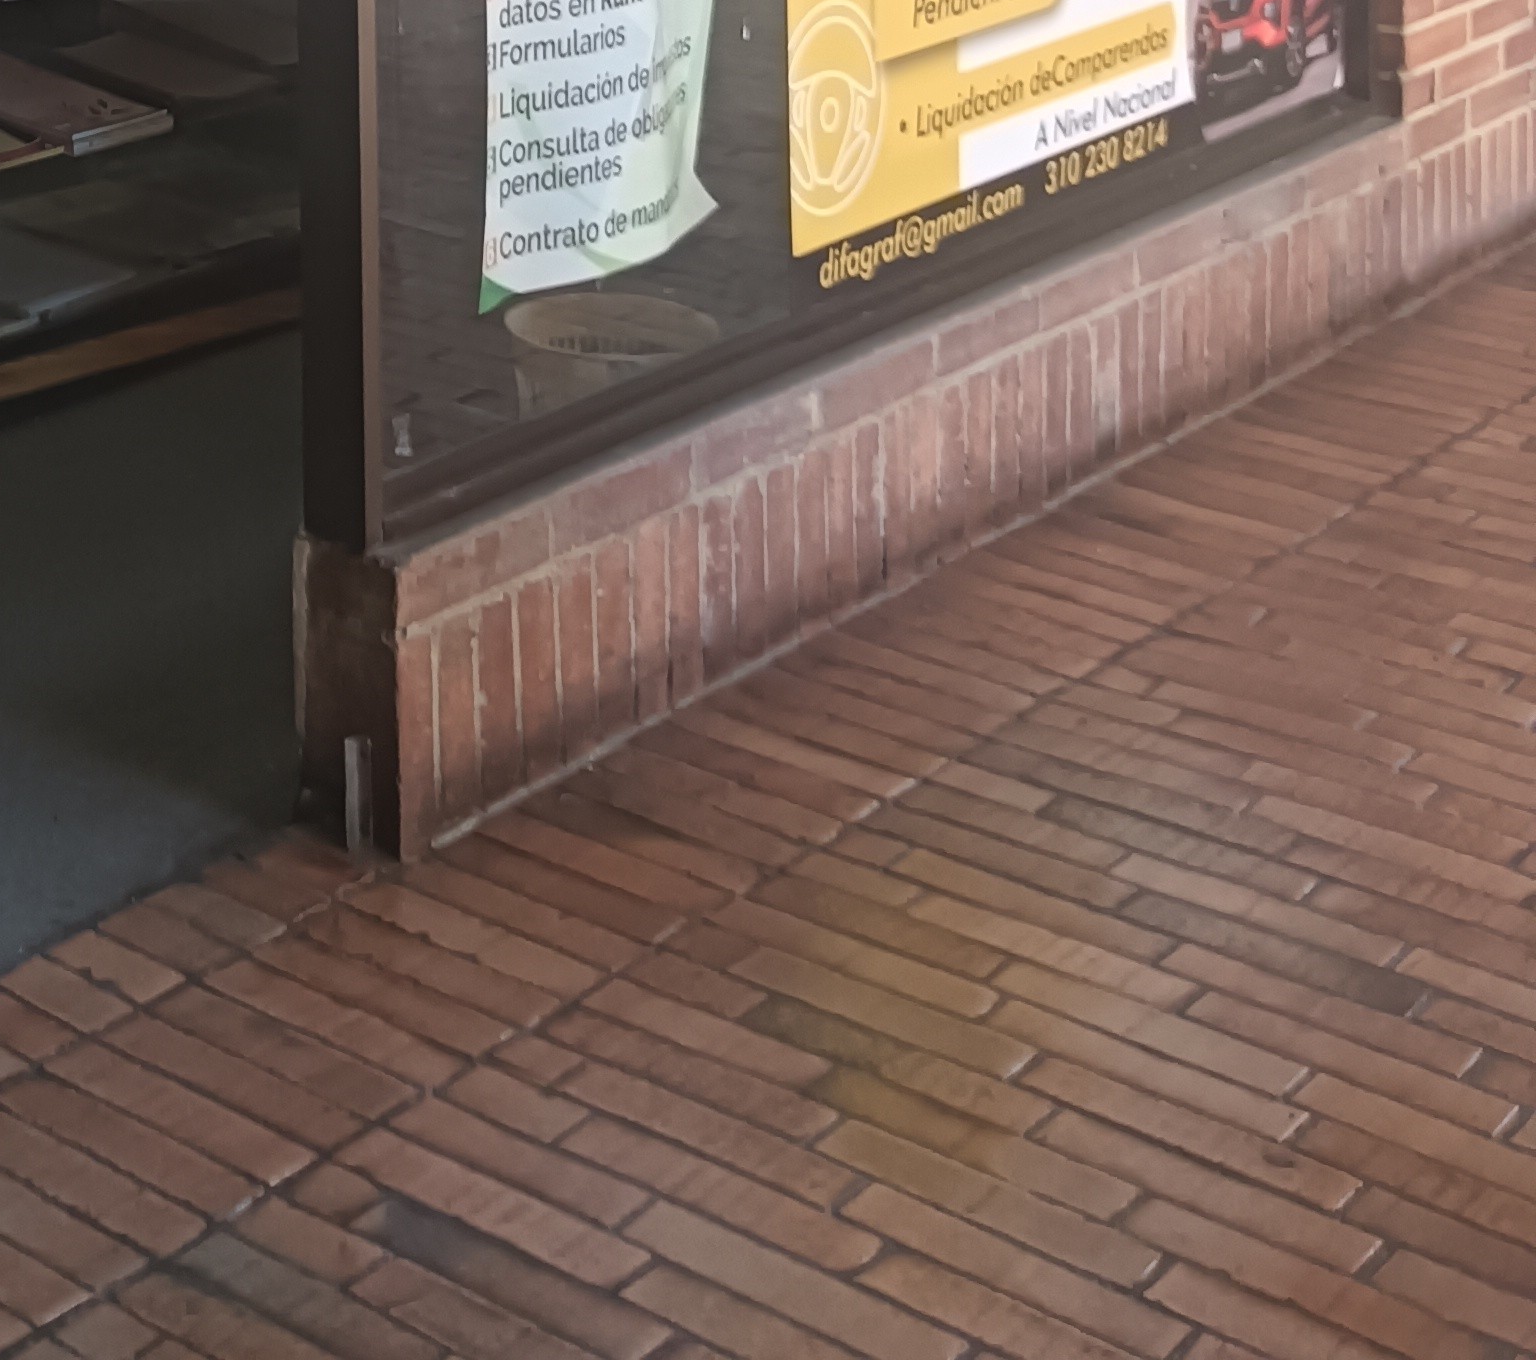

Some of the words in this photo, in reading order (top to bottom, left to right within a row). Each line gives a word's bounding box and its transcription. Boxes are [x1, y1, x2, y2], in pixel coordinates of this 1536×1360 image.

[499, 23, 626, 68] Formularios
[499, 71, 623, 121] Liquidación
[628, 62, 650, 93] de
[915, 75, 1024, 139] Liquidación
[1034, 120, 1050, 151] A
[1052, 96, 1098, 138] Nivel
[1102, 67, 1178, 120] Nacional
[499, 126, 600, 168] Consulta
[604, 117, 627, 147] de
[499, 154, 623, 209] pendientes
[819, 183, 1025, 290] difagraf@gmail.com
[1044, 152, 1082, 195] 310
[1084, 135, 1120, 179] 230
[1122, 117, 1169, 163] 8214
[499, 217, 600, 259] Contrato
[604, 209, 627, 239] de
